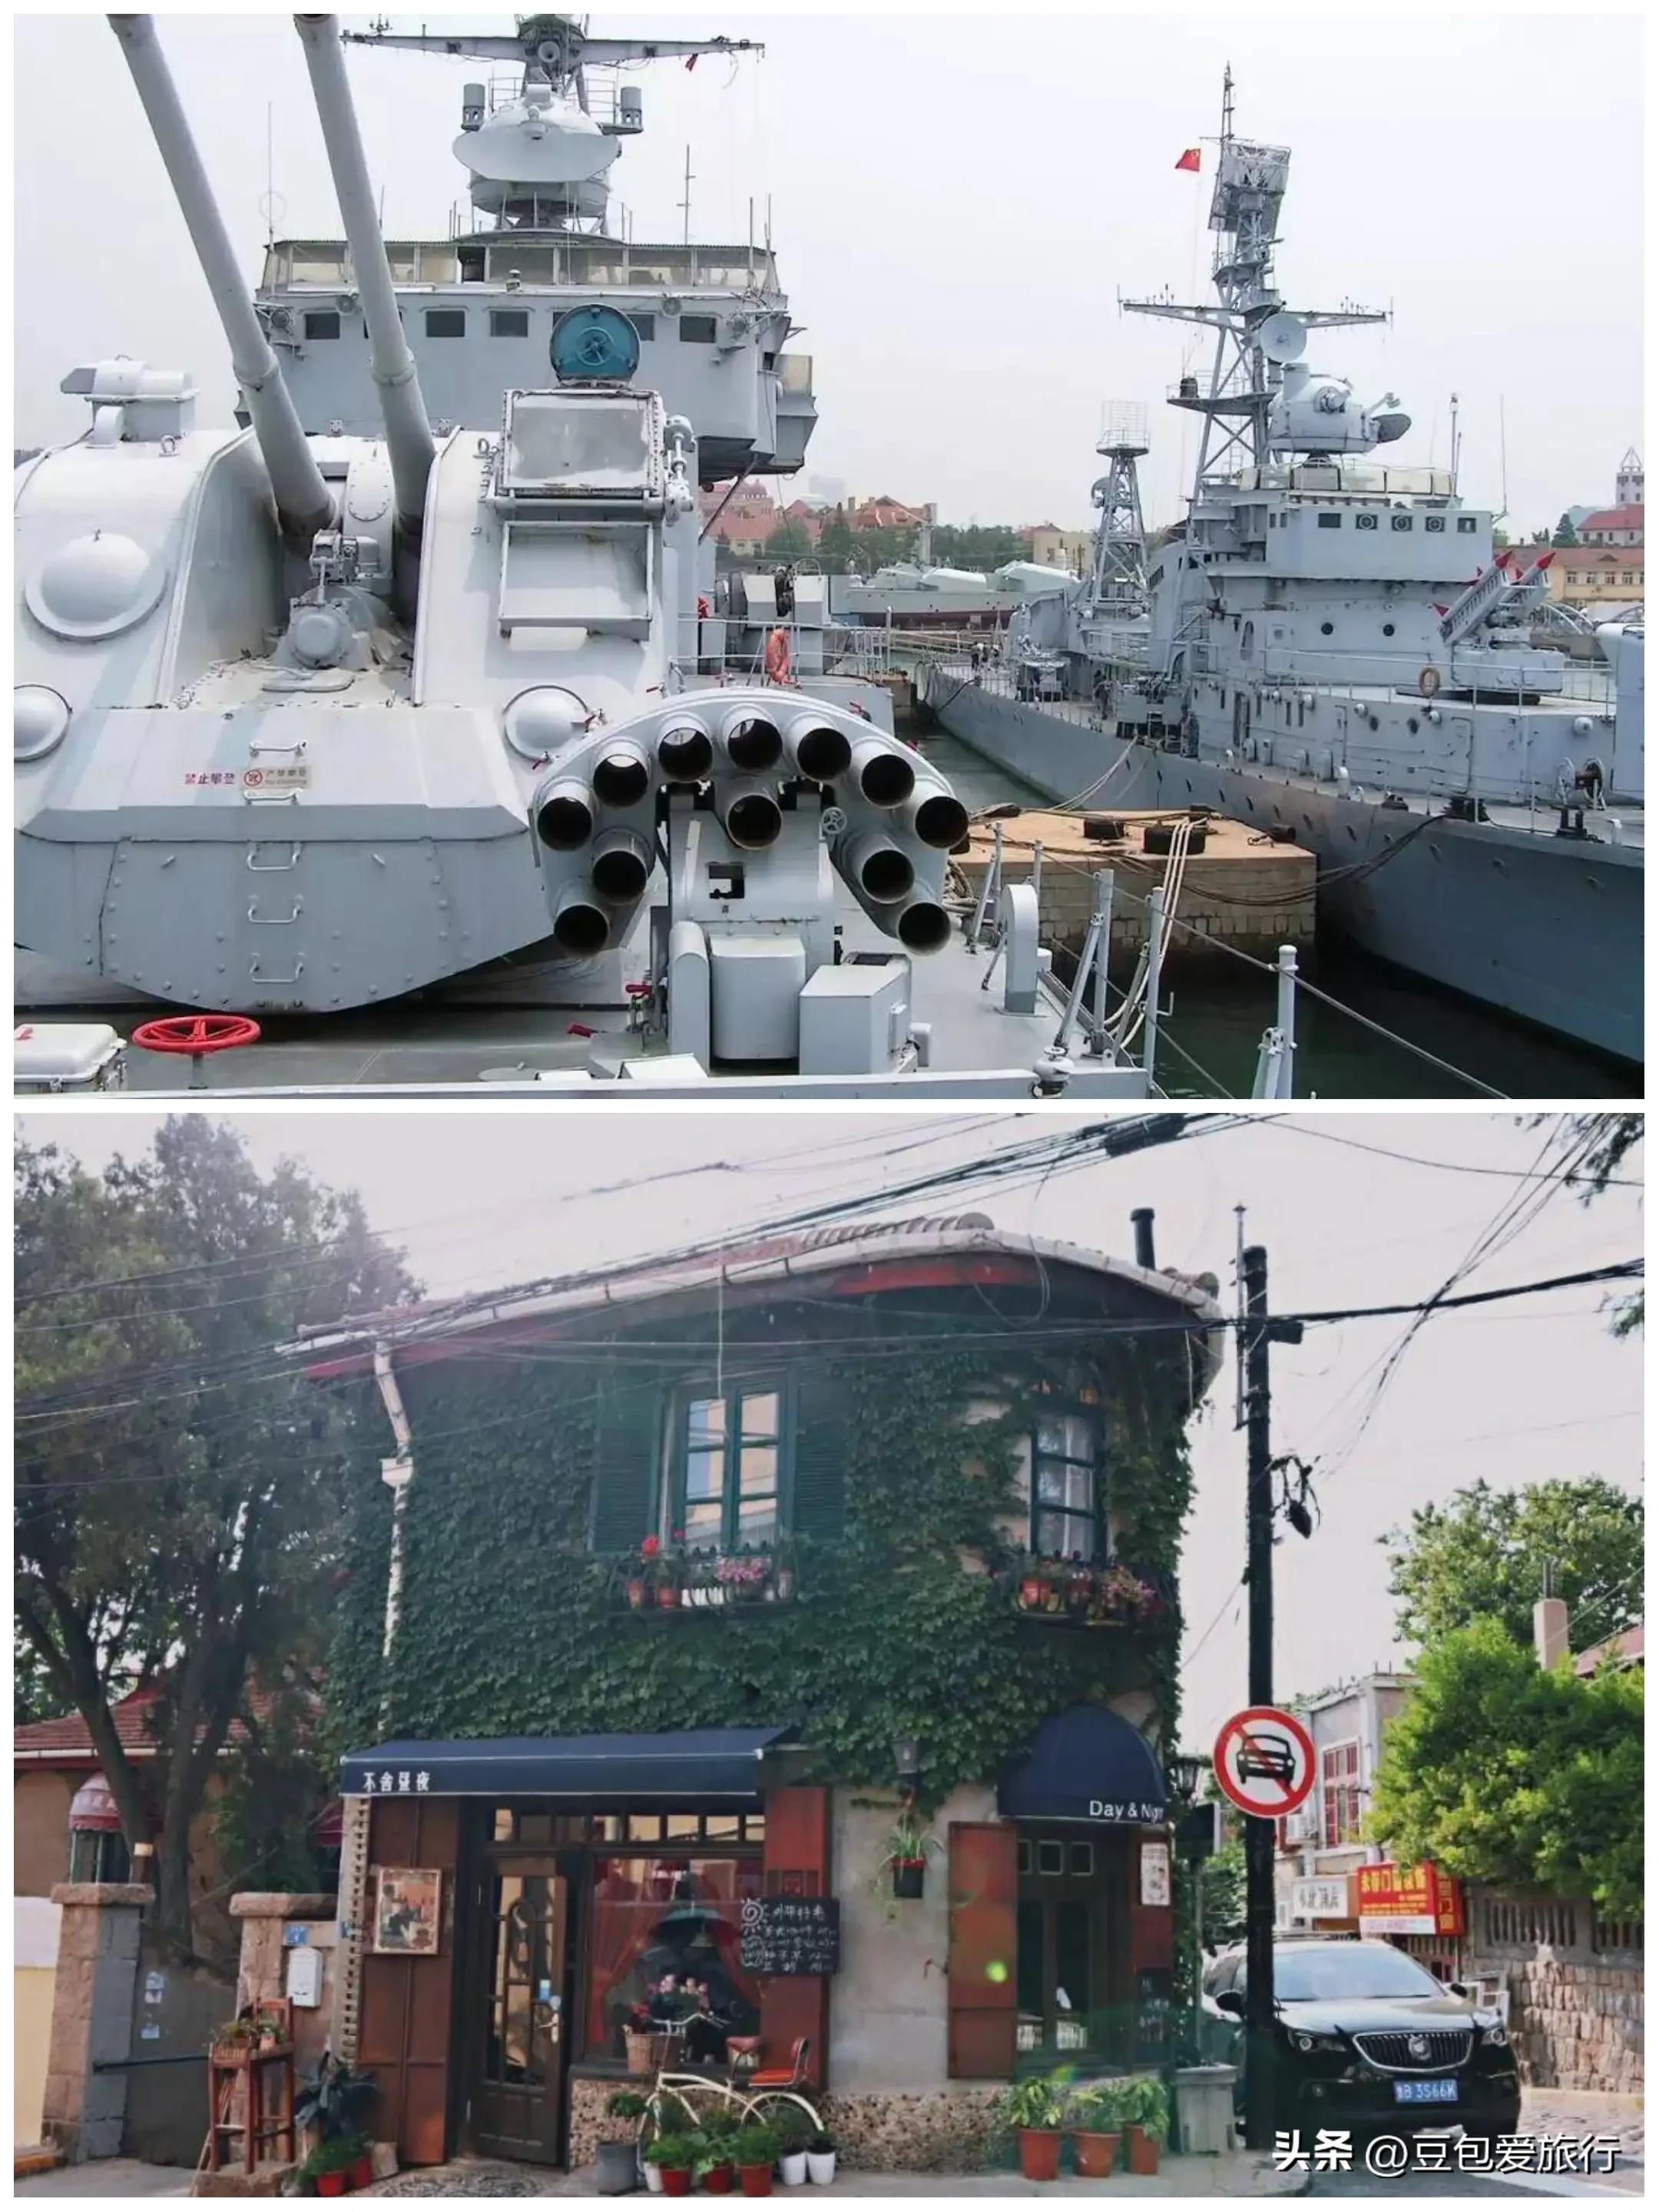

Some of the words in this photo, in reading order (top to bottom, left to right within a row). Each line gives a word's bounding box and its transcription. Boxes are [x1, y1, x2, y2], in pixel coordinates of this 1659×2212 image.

[184, 773, 235, 785] 禁止攀登
[363, 1770, 431, 1792] 不舍昼夜
[1090, 1800, 1124, 1822] Day
[1128, 1802, 1137, 1819] &
